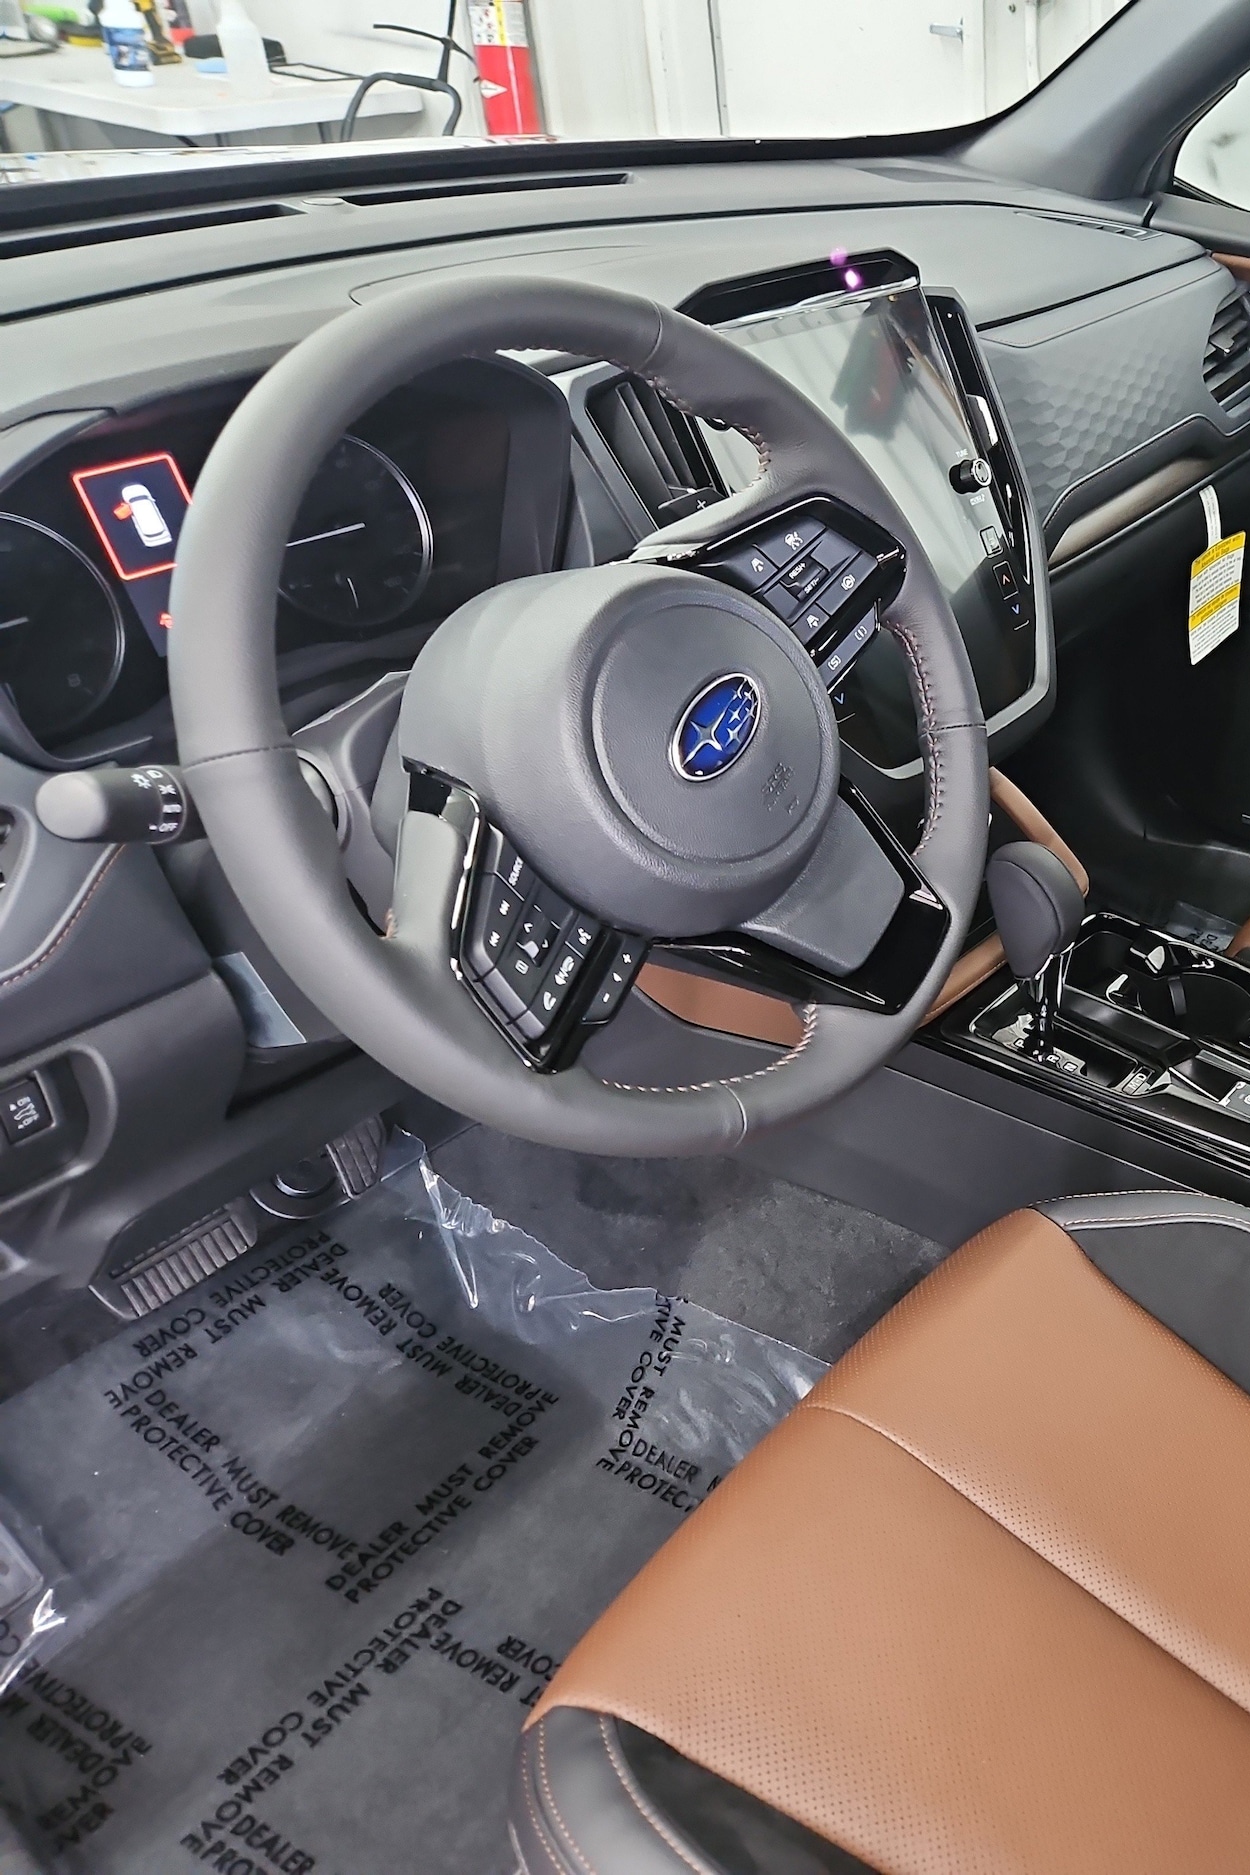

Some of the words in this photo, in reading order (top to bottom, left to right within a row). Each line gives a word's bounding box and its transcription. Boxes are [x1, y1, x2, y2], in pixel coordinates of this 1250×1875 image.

[158, 822, 179, 833] OFF
[208, 1229, 332, 1309] PROTECTIVE
[271, 1242, 348, 1293] DEALER
[132, 1307, 206, 1358] COVER
[203, 1294, 267, 1345] MUST
[320, 1267, 398, 1337] REMOVE
[378, 1282, 437, 1338] COVER
[103, 1343, 199, 1410] REMOVE
[395, 1337, 454, 1379] MUST
[435, 1335, 543, 1401] PROTECTIVE
[653, 1315, 687, 1378] MUST
[454, 1373, 524, 1418] DEALER
[611, 1350, 653, 1421] COVER
[595, 1385, 655, 1472] REMOVE
[631, 1437, 702, 1487] DEALER
[119, 1404, 234, 1512] PROTECTIVE
[228, 1509, 297, 1558] COVER
[144, 1388, 222, 1454] DEALER
[221, 1455, 281, 1510] MUST
[275, 1503, 359, 1561] REMOVE
[323, 1521, 411, 1592] DEALER
[415, 1462, 475, 1517] MUST
[477, 1388, 561, 1460] REMOVE
[344, 1494, 473, 1605] PROTECTIVE
[473, 1434, 541, 1492] COVER
[306, 1586, 445, 1709] PROTECTIVE
[372, 1598, 466, 1676] DEALER
[428, 1630, 522, 1695] REMOVE
[495, 1634, 562, 1681] OVER
[215, 1710, 306, 1786] COVER
[300, 1681, 373, 1751] MUST
[179, 1753, 296, 1855] REMOVE
